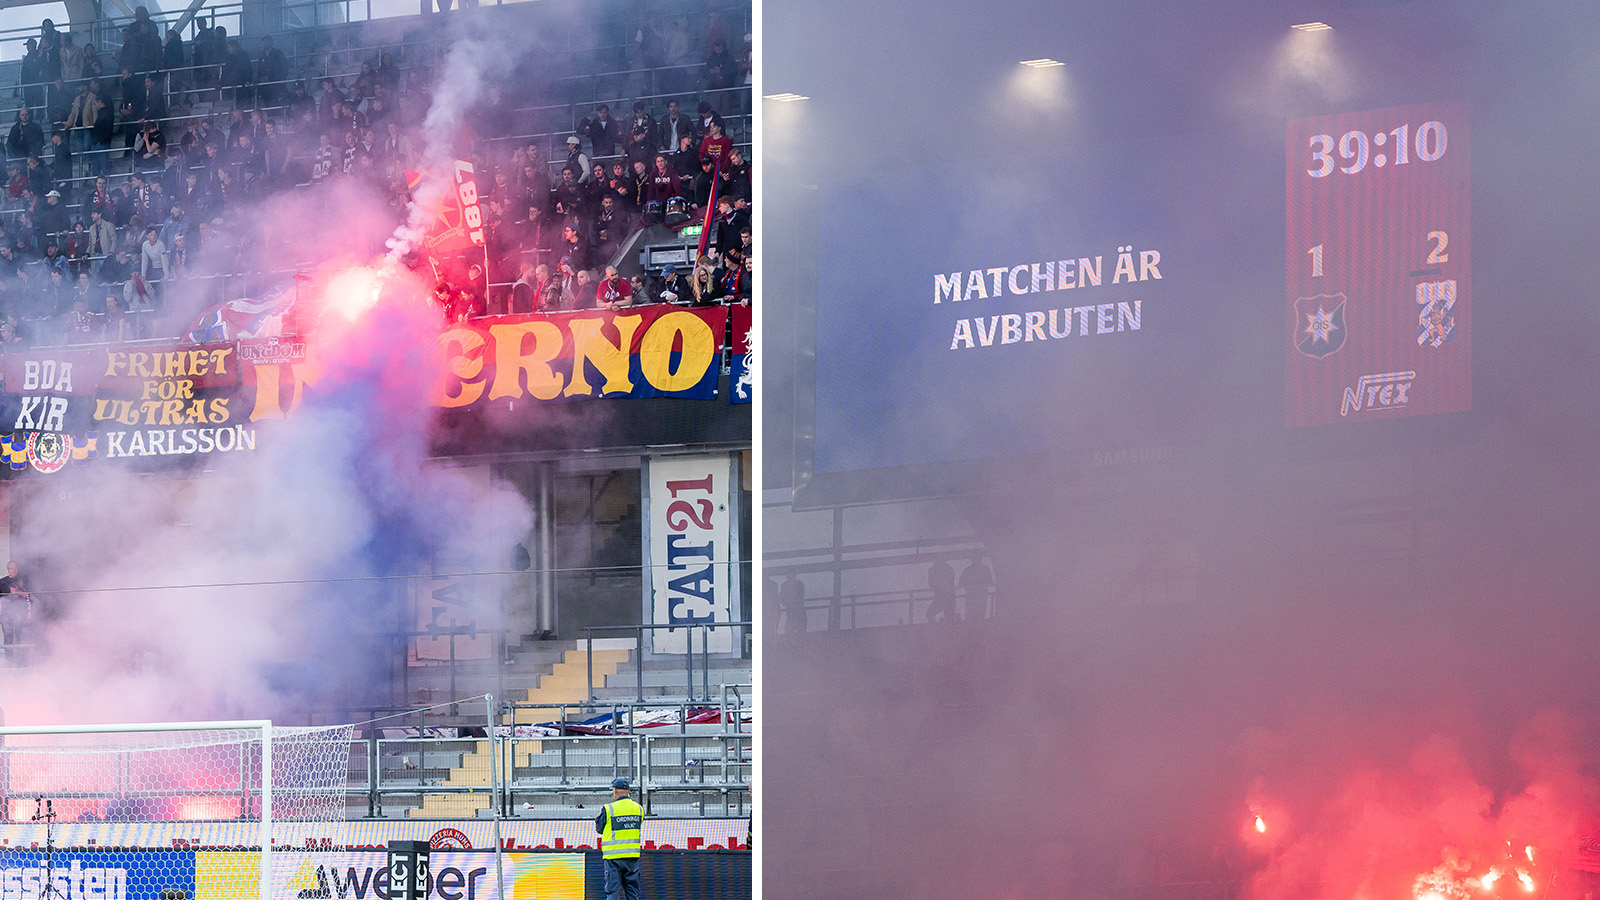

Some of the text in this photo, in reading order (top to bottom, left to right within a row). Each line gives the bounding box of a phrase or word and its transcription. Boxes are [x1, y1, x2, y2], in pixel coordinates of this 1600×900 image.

[1307, 121, 1448, 178] 39:10
[455, 160, 485, 244] 1887
[1308, 244, 1323, 277] 1
[1426, 231, 1449, 264] 2
[934, 245, 1162, 304] MATCHEN ÄR
[950, 300, 1142, 350] AVBRUTEN
[104, 347, 233, 378] FRIHET
[241, 343, 304, 360] UNGDOM
[249, 311, 715, 423] IERNO
[23, 360, 72, 392] BDA
[142, 377, 194, 400] FÖR
[1340, 370, 1416, 417] NTEX
[15, 396, 68, 431] KIR
[93, 398, 230, 425] ULTRAS
[107, 425, 256, 457] KARLSSON
[666, 474, 715, 632] FAT21
[0, 859, 127, 900] ssisten
[331, 866, 487, 900] weer
